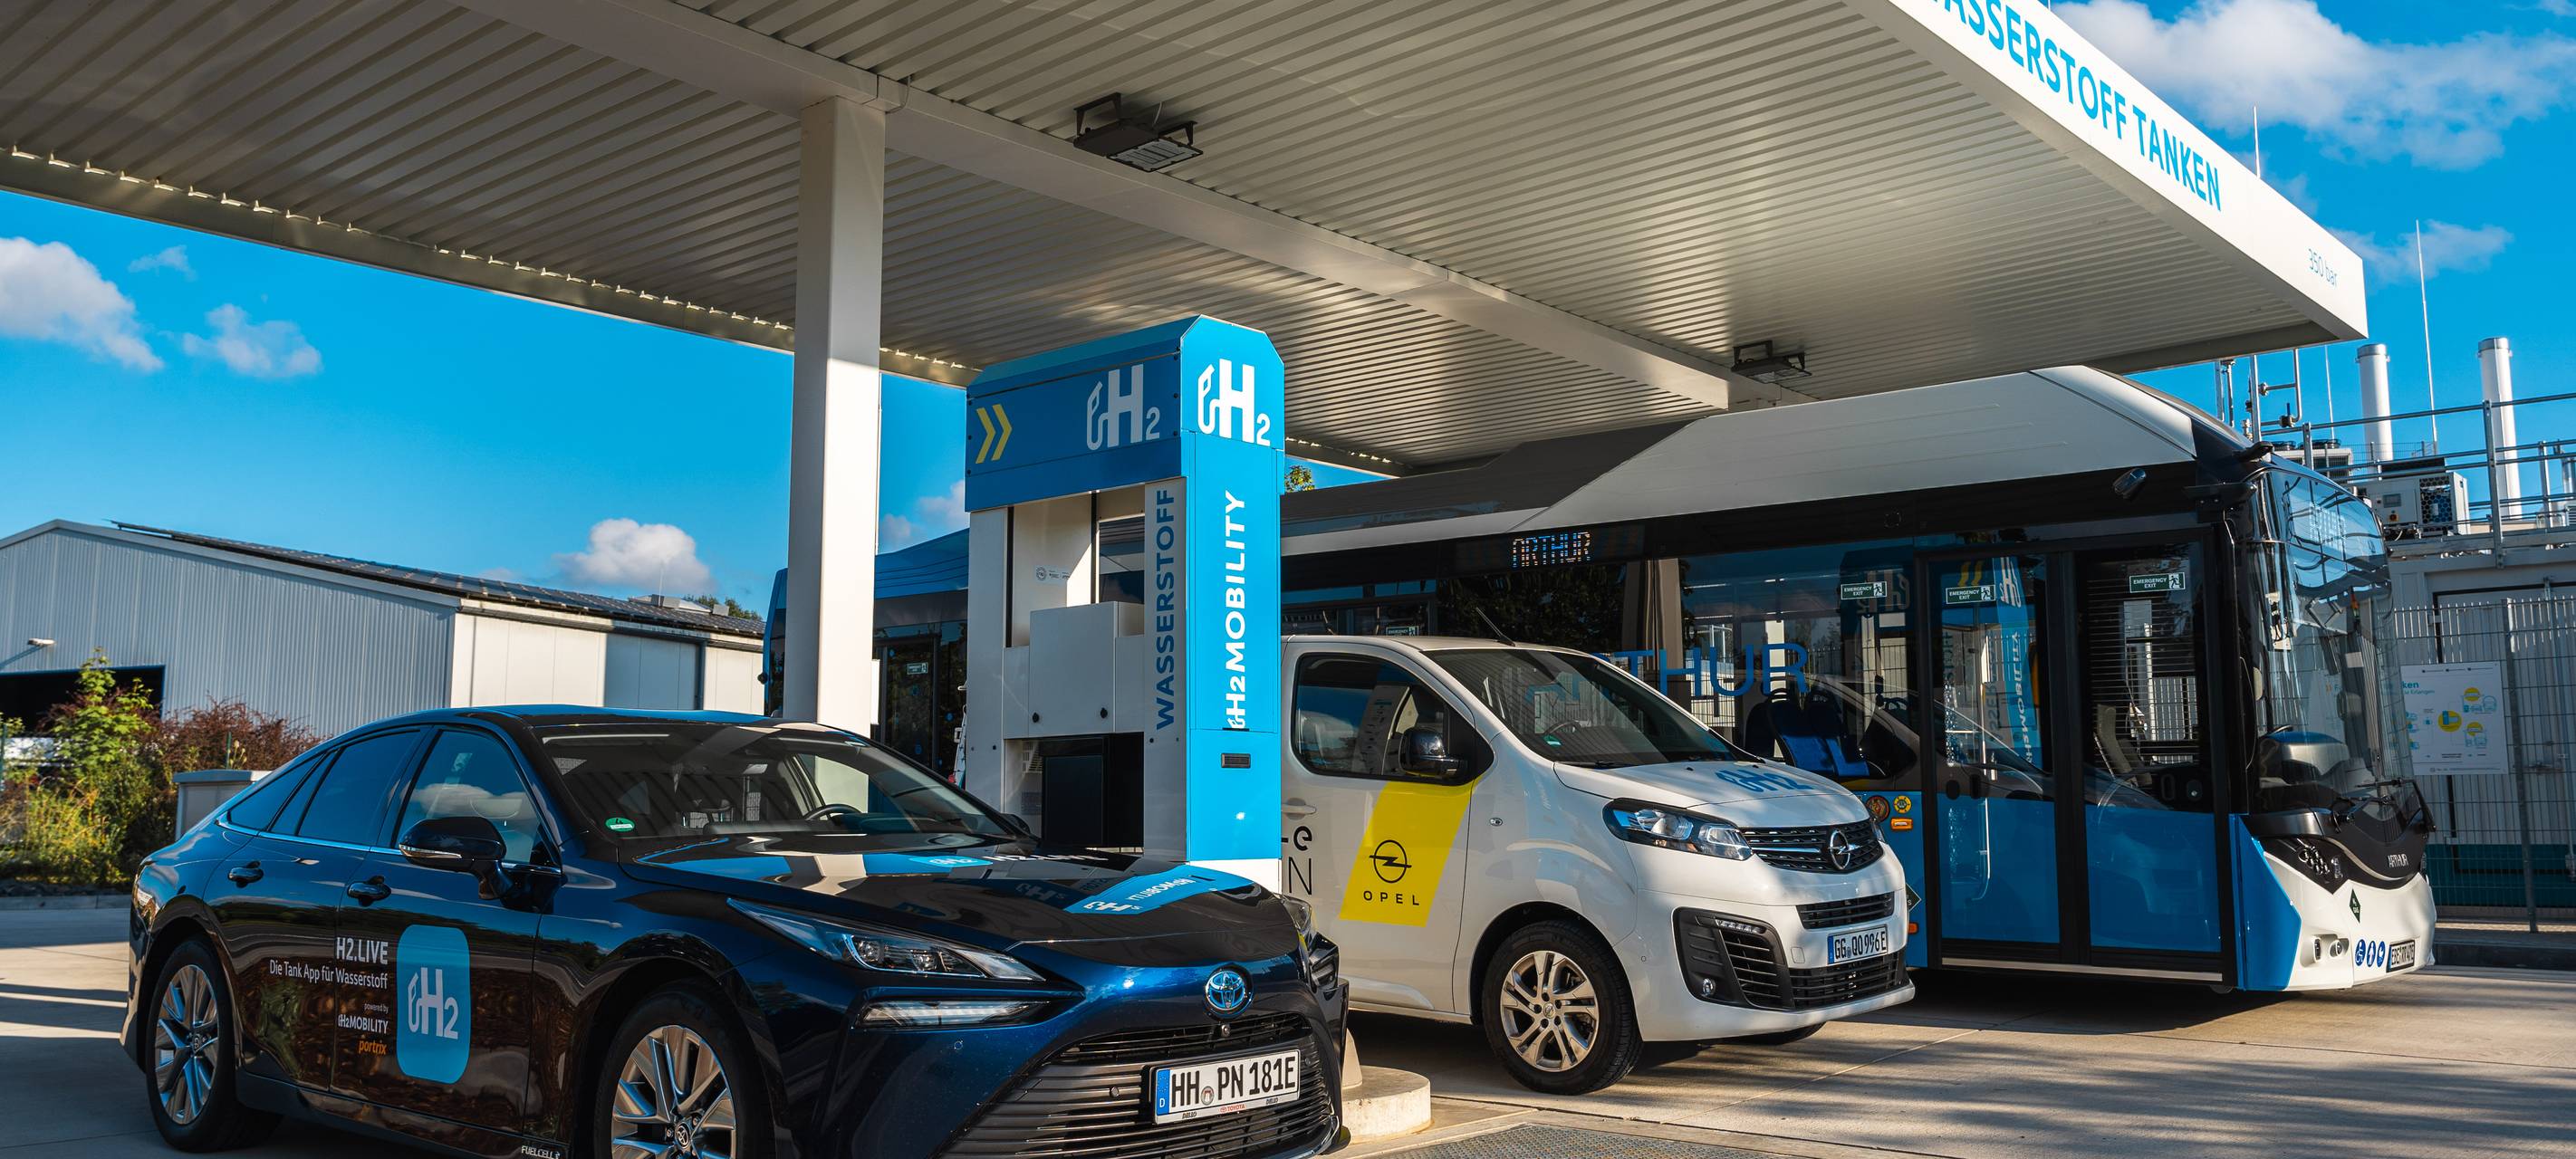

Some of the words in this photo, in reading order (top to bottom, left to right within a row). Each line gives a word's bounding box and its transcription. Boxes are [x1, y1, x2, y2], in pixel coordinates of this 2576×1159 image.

[1931, 0, 2127, 139] SSERSTOFF
[2132, 105, 2222, 211] TANKEN
[2309, 248, 2323, 276] 350
[2324, 259, 2337, 289] bar
[1512, 532, 1591, 567] ARTHUR
[1156, 489, 1175, 731] WASSERSTOFF
[1591, 642, 1810, 698] THUR
[2388, 854, 2409, 868] ARTHUR
[1363, 890, 1419, 905] OPEL
[336, 937, 389, 965] H2.LIVE
[1835, 938, 1846, 959] GG
[270, 960, 283, 975] Die
[284, 962, 303, 978] Tank
[303, 963, 320, 983] App
[322, 965, 333, 982] für
[335, 967, 388, 990] Wasserstoff
[364, 1003, 381, 1011] powered
[382, 1004, 389, 1014] by
[359, 1039, 387, 1055] portrix
[1171, 1070, 1200, 1107] HH
[1217, 1064, 1244, 1101] PN
[1249, 1056, 1295, 1095] 181E
[1227, 1104, 1245, 1113] TOYOTA
